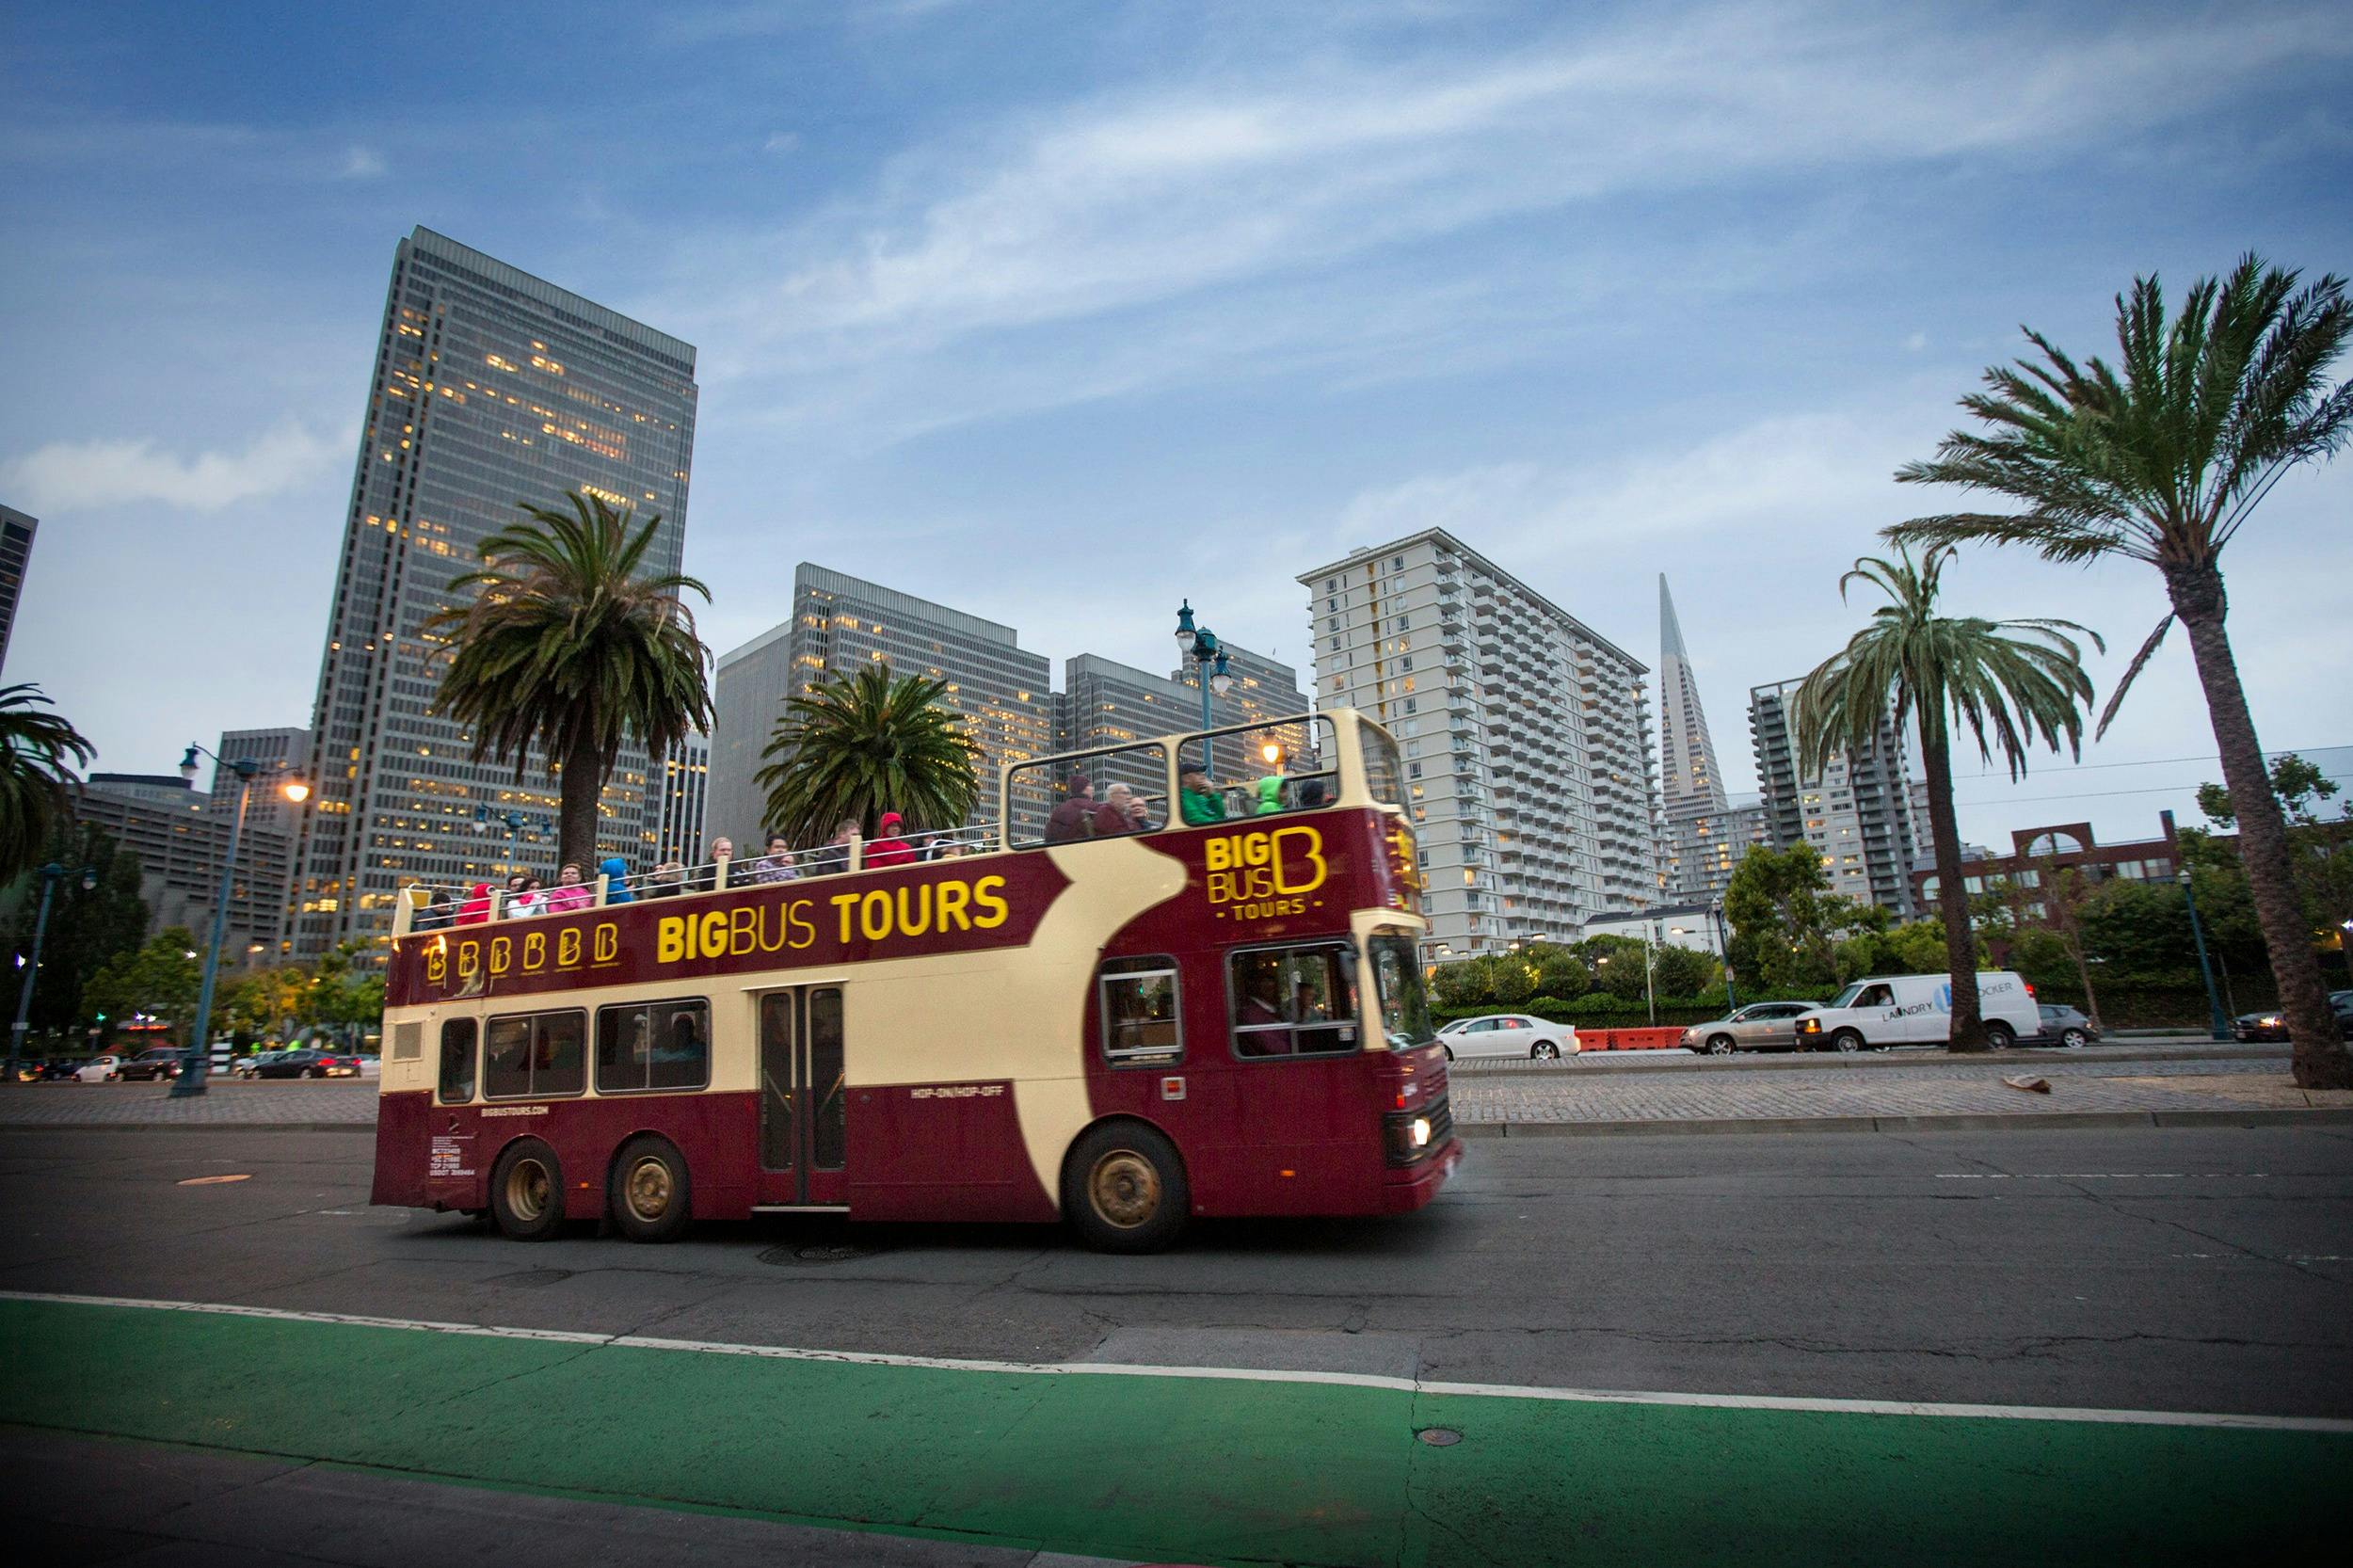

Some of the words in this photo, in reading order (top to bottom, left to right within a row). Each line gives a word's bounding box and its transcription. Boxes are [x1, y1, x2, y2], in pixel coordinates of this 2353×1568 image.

[1205, 832, 1270, 872] BIG
[1207, 867, 1274, 904] BUS
[829, 874, 1010, 945] TOURS
[1230, 898, 1306, 921] TOURS
[1978, 982, 2012, 998] OCKER
